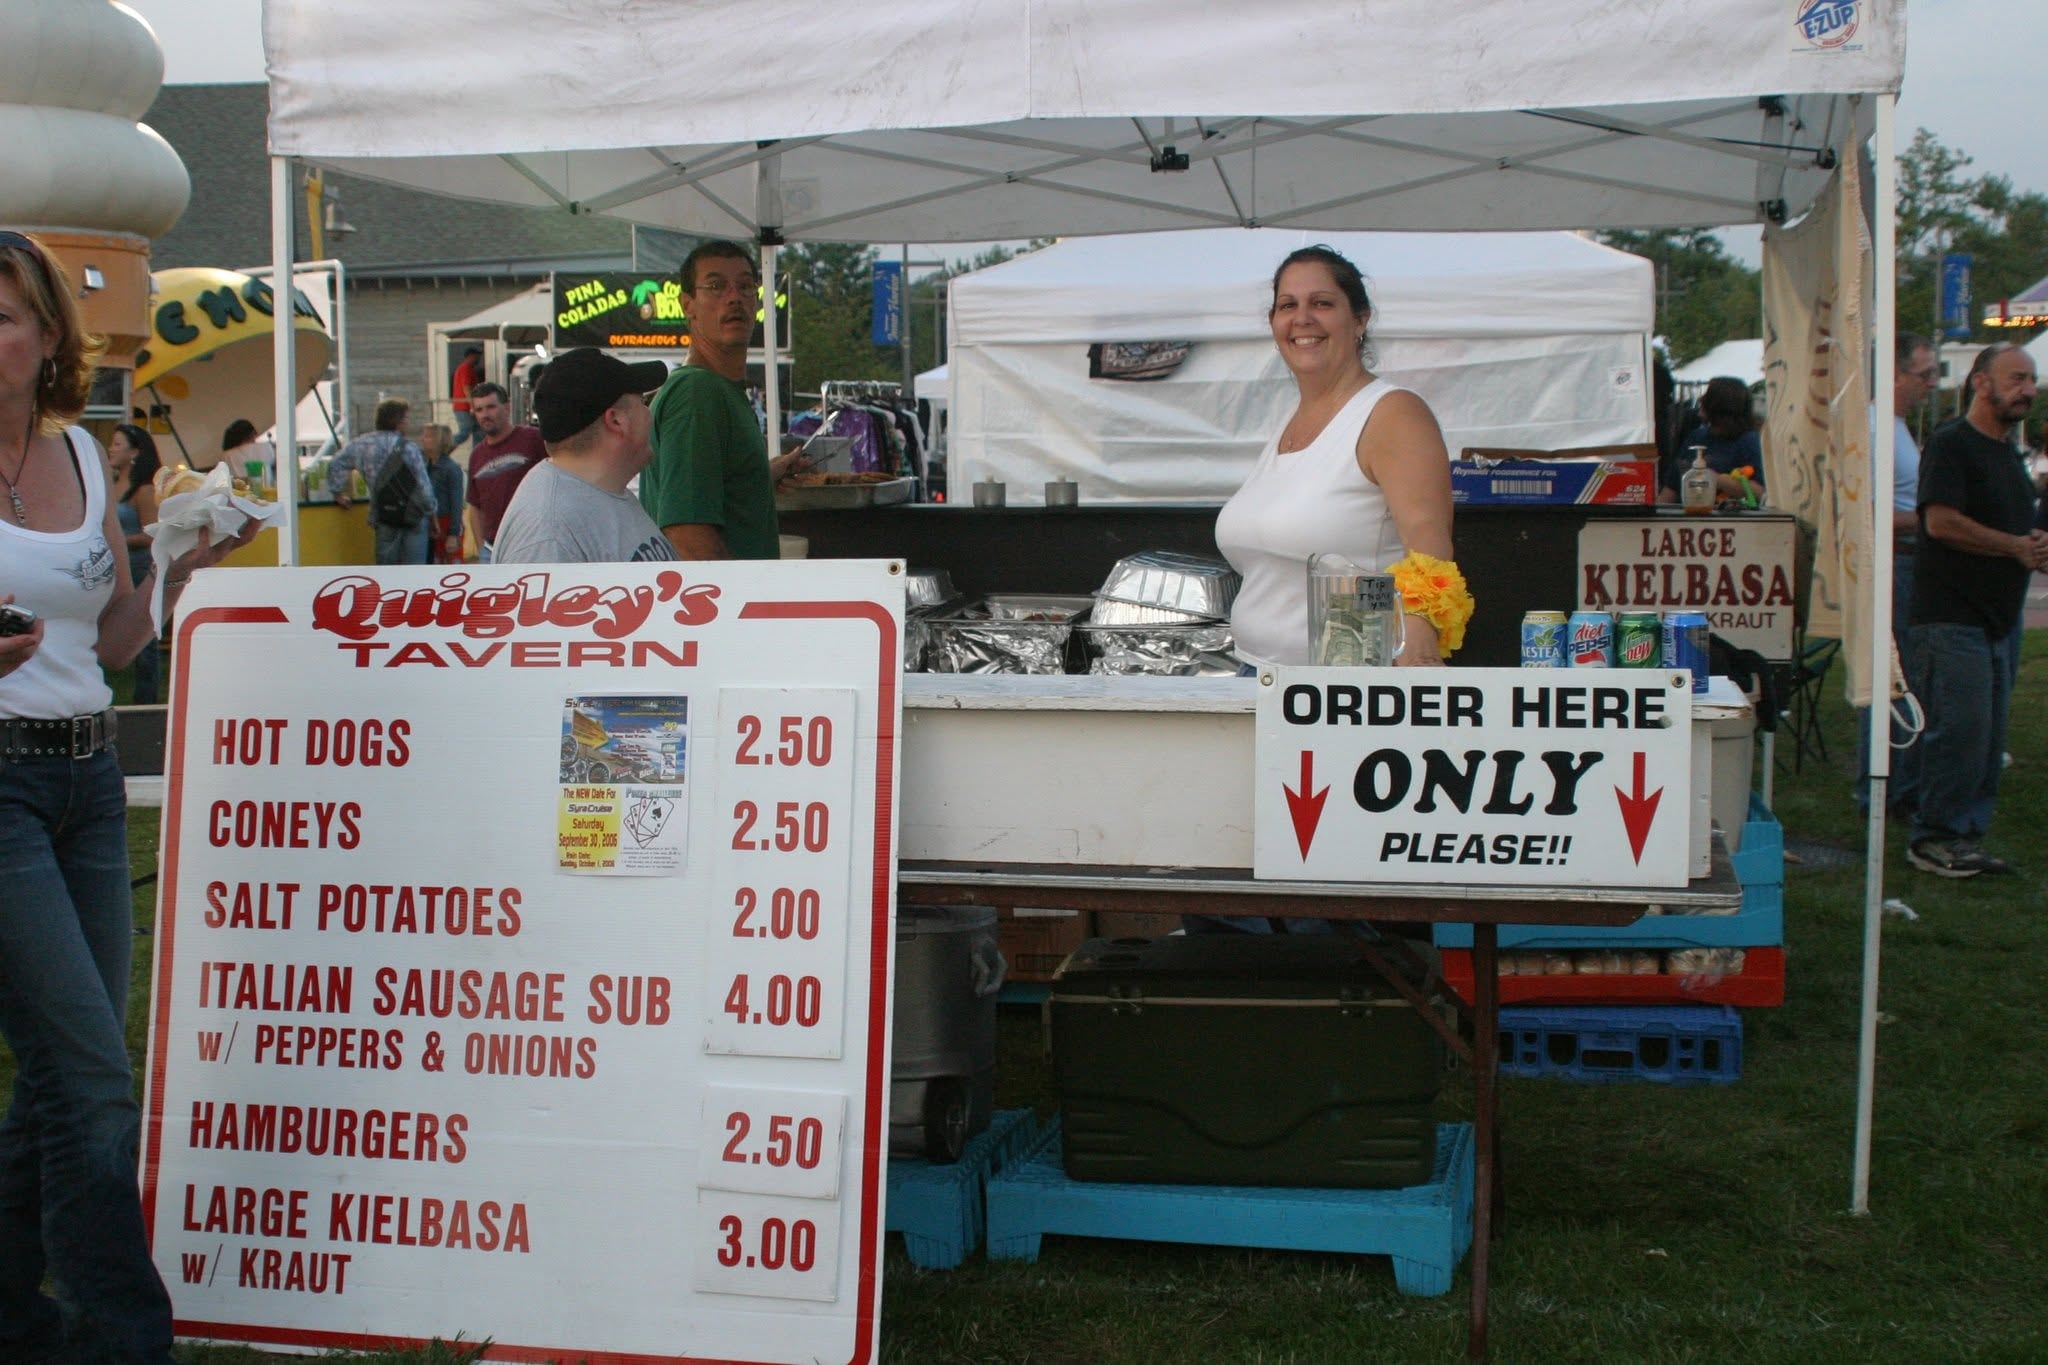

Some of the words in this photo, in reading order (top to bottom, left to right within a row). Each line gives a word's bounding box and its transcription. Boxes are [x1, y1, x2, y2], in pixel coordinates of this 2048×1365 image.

[558, 289, 628, 328] COLADAS
[565, 279, 606, 306] PINA
[1640, 527, 1736, 558] LARGE
[312, 570, 721, 639] Quigley's
[1583, 563, 1794, 607] KIELBASA
[338, 640, 700, 669] TAVERN
[1568, 636, 1612, 656] PEPSI
[1575, 620, 1607, 641] diet
[1282, 684, 1485, 728] ORDER
[1511, 686, 1668, 730] HERE
[212, 718, 290, 767] HOT
[306, 719, 412, 768] DOGS
[735, 715, 834, 767] 2.50
[563, 788, 575, 799] The
[576, 788, 590, 799] NEW
[1352, 748, 1604, 817] ONLY
[208, 800, 362, 850] CONEYS
[559, 833, 589, 850] September
[572, 818, 605, 832] Saturday
[731, 800, 830, 854] 2.50
[1379, 831, 1574, 867] PLEASE!!
[204, 880, 301, 932] SALT
[317, 883, 522, 938] POTATOES
[732, 886, 822, 941] 2.00
[199, 960, 354, 1016] ITALIAN
[373, 966, 566, 1024] SAUSAGE
[587, 974, 673, 1027] SUB
[724, 973, 823, 1029] 4.00
[254, 1024, 404, 1070] PEPPERS
[421, 1030, 445, 1073] &
[464, 1032, 598, 1080] ONIONS
[188, 1100, 470, 1164] HAMBURGERS
[722, 1110, 823, 1170] 2.50
[182, 1184, 309, 1240] LARGE
[328, 1192, 531, 1254] KIELBASA
[716, 1215, 818, 1272] 3.00
[238, 1247, 353, 1296] KRAUT
